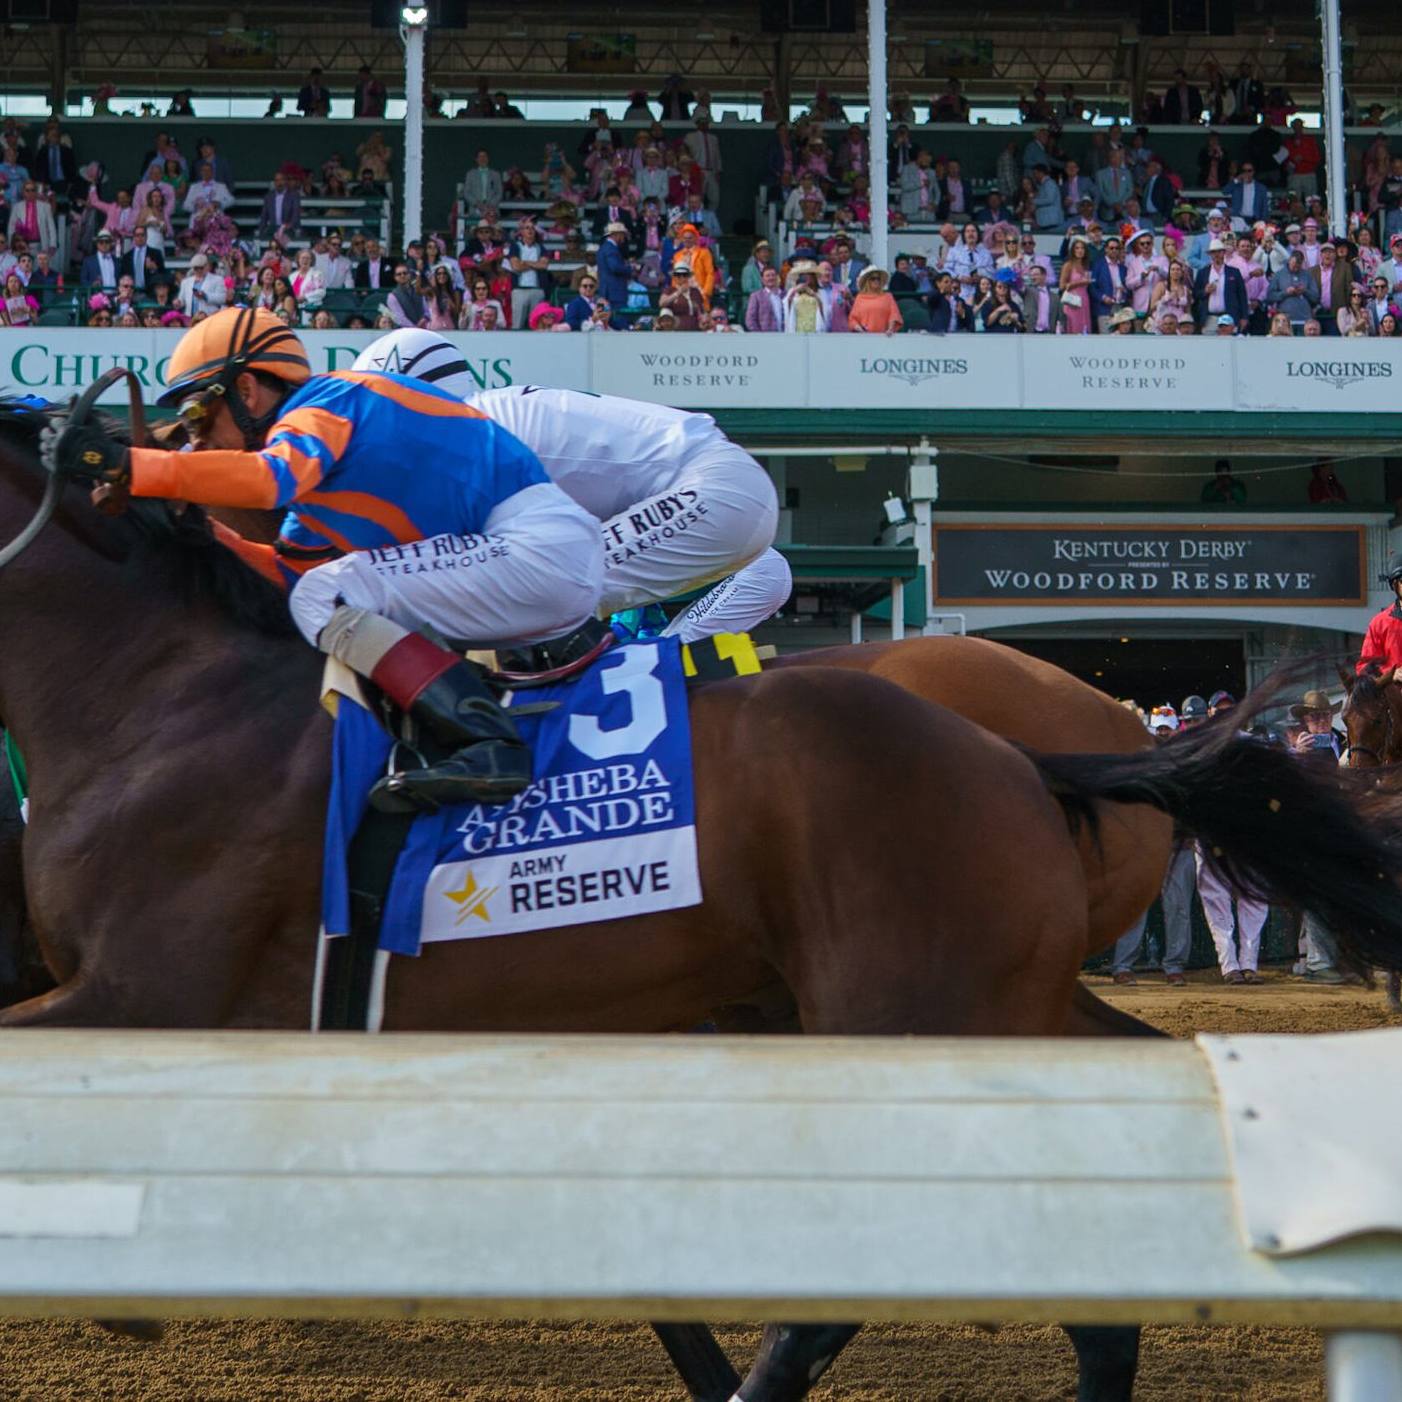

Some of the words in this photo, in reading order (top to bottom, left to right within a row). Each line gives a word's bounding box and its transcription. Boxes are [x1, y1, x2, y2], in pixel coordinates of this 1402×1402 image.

[11, 344, 173, 387] CHURC
[324, 346, 513, 389] DNS
[640, 354, 759, 367] WOODFORD
[860, 358, 968, 375] LONGINES
[1069, 356, 1186, 370] WOODFORD
[1287, 362, 1393, 377] LONGINES
[653, 373, 750, 386] RESERVE
[1082, 375, 1178, 389] RESERVE
[604, 501, 709, 569] EAKHOUSE
[369, 543, 426, 566] JEFF
[1054, 540, 1170, 562] KENTUCKY
[1179, 539, 1246, 560] DERBY
[984, 570, 1159, 590] WOODFORD
[1171, 571, 1311, 590] RESERVE
[568, 643, 668, 760] 3
[456, 759, 671, 833] AYSHEBA
[463, 791, 674, 854] GRANDE
[509, 854, 567, 879] ARMY
[510, 860, 671, 913] RESERVE
